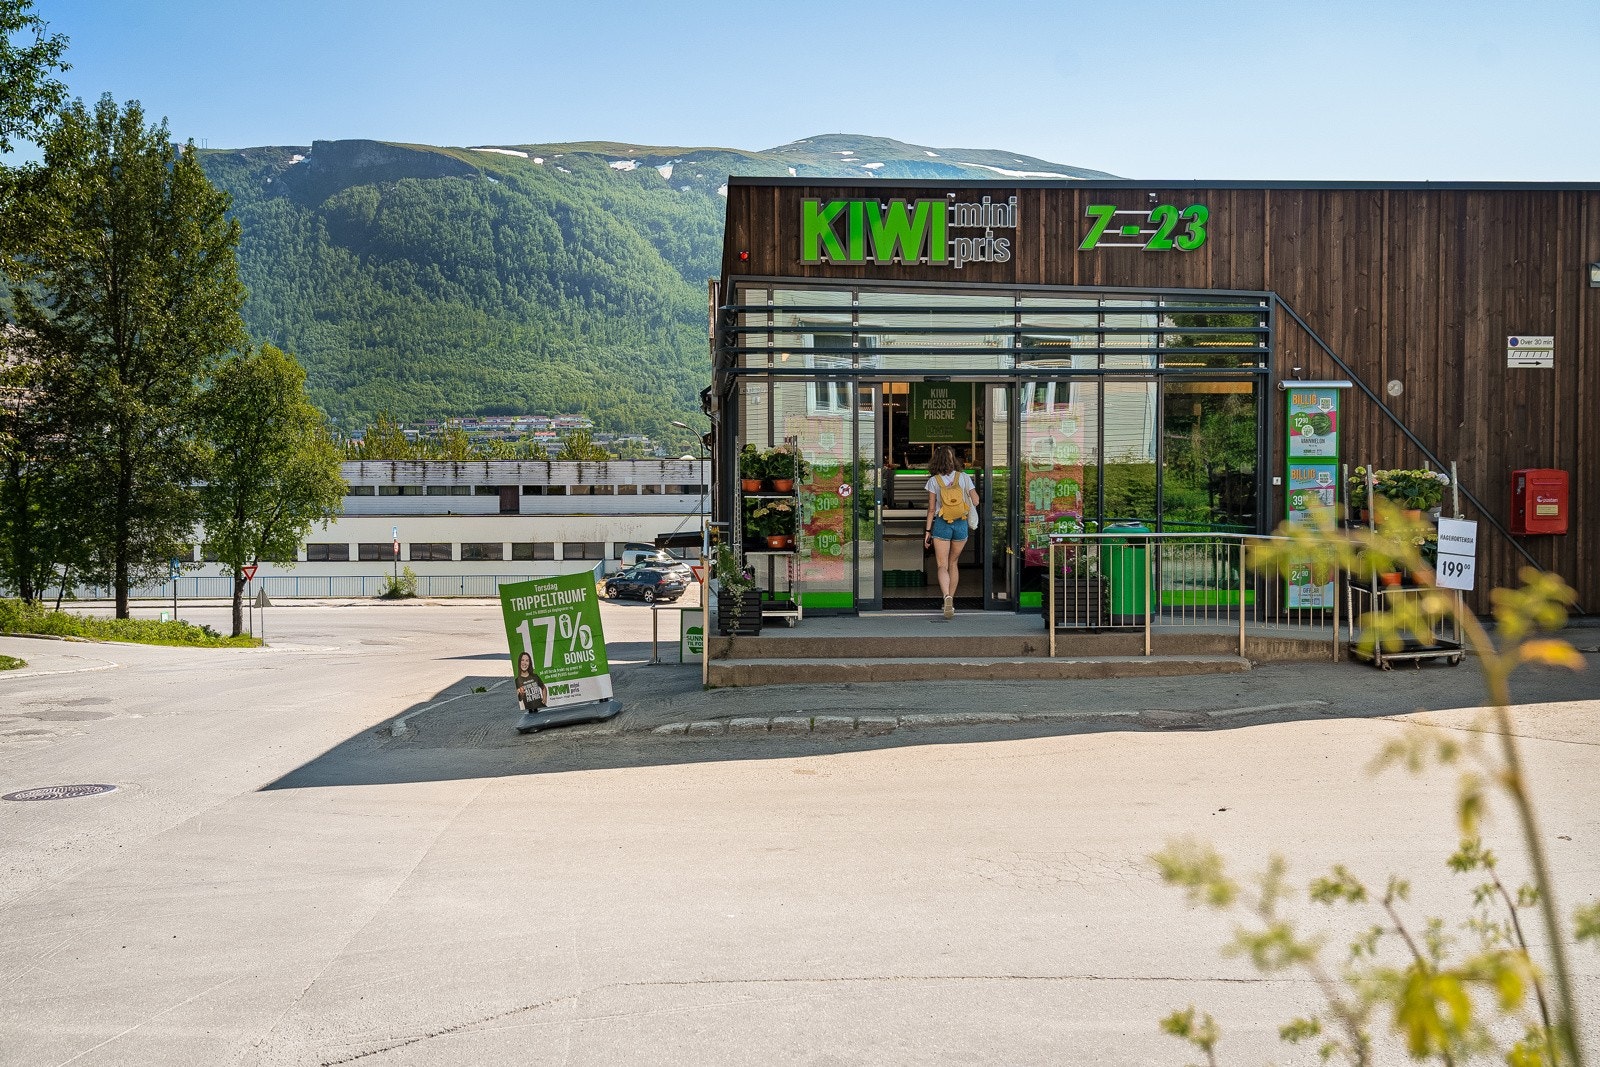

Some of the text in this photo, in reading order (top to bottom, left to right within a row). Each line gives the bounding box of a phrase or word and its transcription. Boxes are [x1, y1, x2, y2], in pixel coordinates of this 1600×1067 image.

[954, 196, 1017, 227] mini
[801, 198, 948, 265] KIWI
[954, 230, 1010, 268] pris
[930, 388, 948, 398] KIWI
[1292, 394, 1317, 405] BILLIG
[922, 399, 957, 409] PRESSER
[924, 409, 955, 420] PRISENE
[1291, 469, 1316, 480] BILLIG
[534, 583, 558, 593] Torsdag
[510, 588, 587, 612] TRIPPELTRUMF
[516, 612, 594, 670] 17%
[564, 649, 596, 665] BONUS
